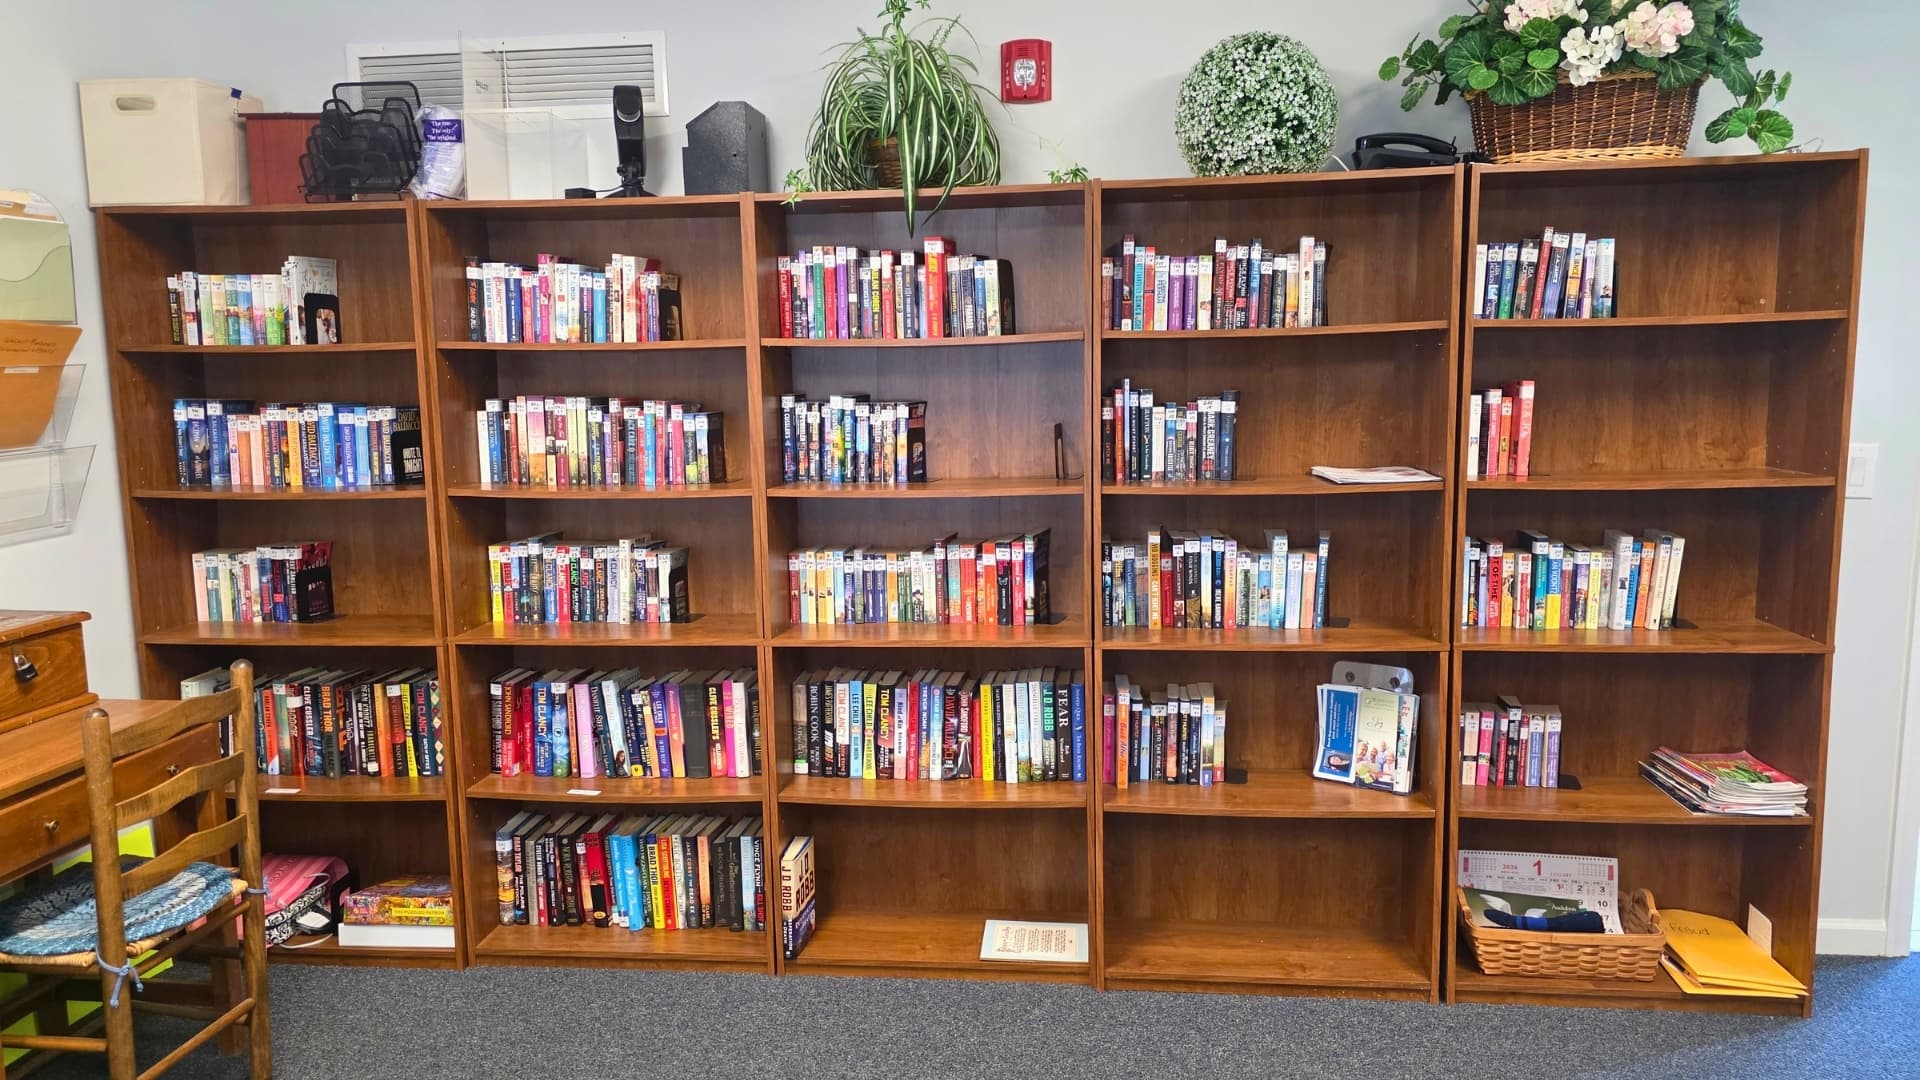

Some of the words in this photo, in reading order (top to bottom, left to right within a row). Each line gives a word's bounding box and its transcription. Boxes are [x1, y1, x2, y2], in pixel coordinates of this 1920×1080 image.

[595, 563, 604, 585] CLANCY
[1492, 566, 1498, 578] OF
[304, 686, 312, 705] CLIVE
[321, 686, 332, 708] BRAD
[416, 687, 425, 704] TOM
[504, 686, 512, 702] JOHN
[538, 687, 546, 704] TOM
[709, 687, 717, 706] CLIVE
[810, 685, 818, 713] ROBIN
[824, 684, 832, 700] JAMES
[837, 688, 846, 705] TOM
[880, 689, 889, 707] TOM
[960, 694, 968, 707] JOHN
[656, 710, 664, 724] CHILD
[824, 699, 832, 724] PATTERSON
[865, 708, 873, 726] CHILD
[1044, 706, 1054, 731] ROBB
[1058, 689, 1069, 728] FEAR
[304, 706, 314, 736] CUSSLER
[323, 708, 333, 733] THOR
[417, 705, 428, 737] CLANCY
[504, 703, 512, 735] SANDFORD
[538, 705, 547, 737] CLANCY
[710, 706, 720, 740] CUSSLER'S
[810, 715, 819, 742] COOK
[837, 706, 846, 737] CLANCY
[880, 707, 889, 740] CLANCY
[960, 707, 969, 733] SANDFORD
[1120, 740, 1128, 758] After
[513, 836, 521, 852] BRAD
[561, 846, 570, 862] NORA
[753, 840, 761, 862] VINCE
[514, 852, 523, 873] TAYLOR
[649, 846, 657, 865] BRAD
[650, 866, 658, 885] THOR
[1533, 860, 1542, 876] 1
[782, 885, 792, 911] ROBB
[689, 906, 695, 914] EX
